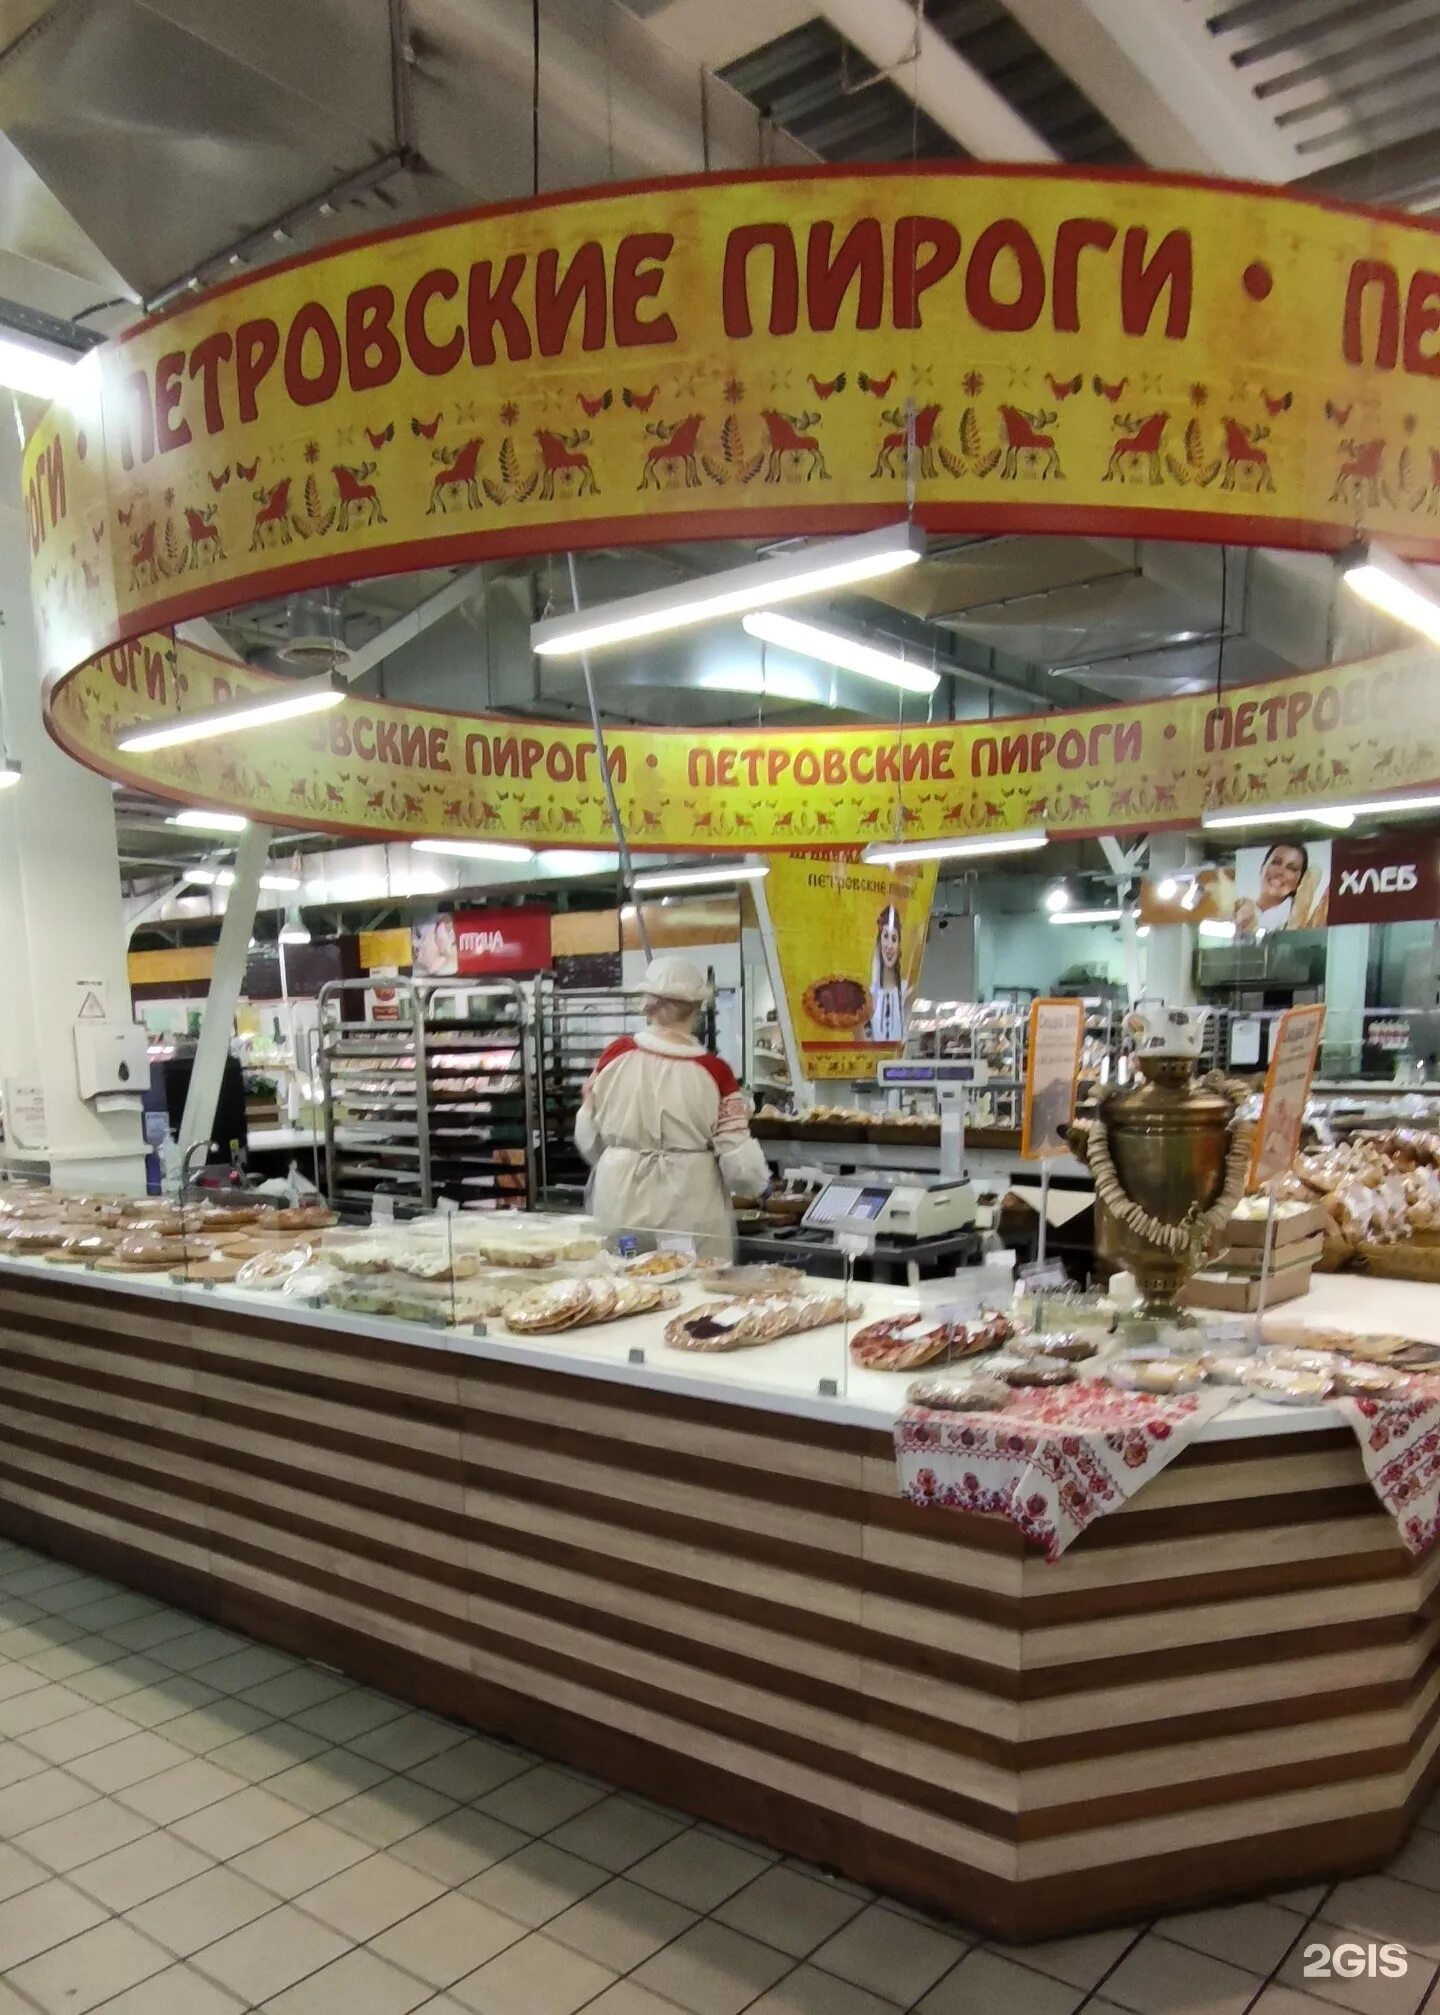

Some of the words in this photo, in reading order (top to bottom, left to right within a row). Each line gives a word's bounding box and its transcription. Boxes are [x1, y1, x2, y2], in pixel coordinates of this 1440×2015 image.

[121, 233, 677, 471] ПЕТРОВСКИЕ
[723, 215, 1193, 339] ПИРОГИ
[25, 433, 66, 557] ОГИ
[465, 733, 626, 783] ПИРОГИ
[688, 740, 954, 787] ПЕТРОВСКИЕ
[971, 720, 1142, 778] ПИРОГИ
[1338, 864, 1417, 896] ХЛЕБ
